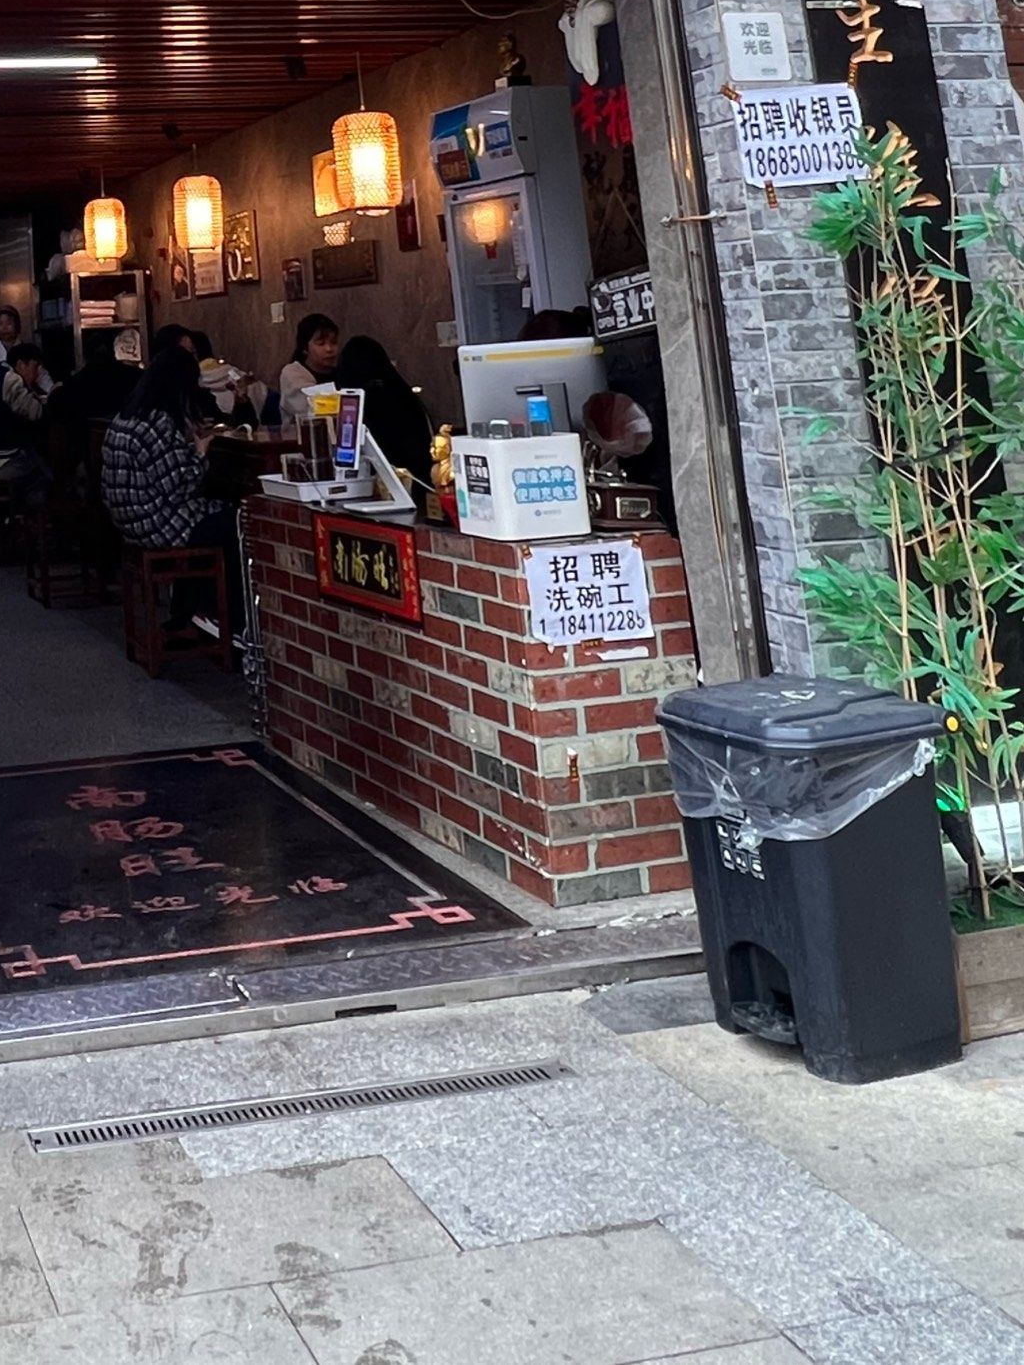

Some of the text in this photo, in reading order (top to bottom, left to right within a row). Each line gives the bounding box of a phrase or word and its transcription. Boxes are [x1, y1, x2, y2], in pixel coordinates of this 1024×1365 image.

[739, 21, 771, 37] 欢迎
[743, 39, 774, 56] 光临
[737, 95, 859, 143] 招聘收银员
[549, 550, 621, 584] 招聘
[546, 583, 634, 612] 洗碗工
